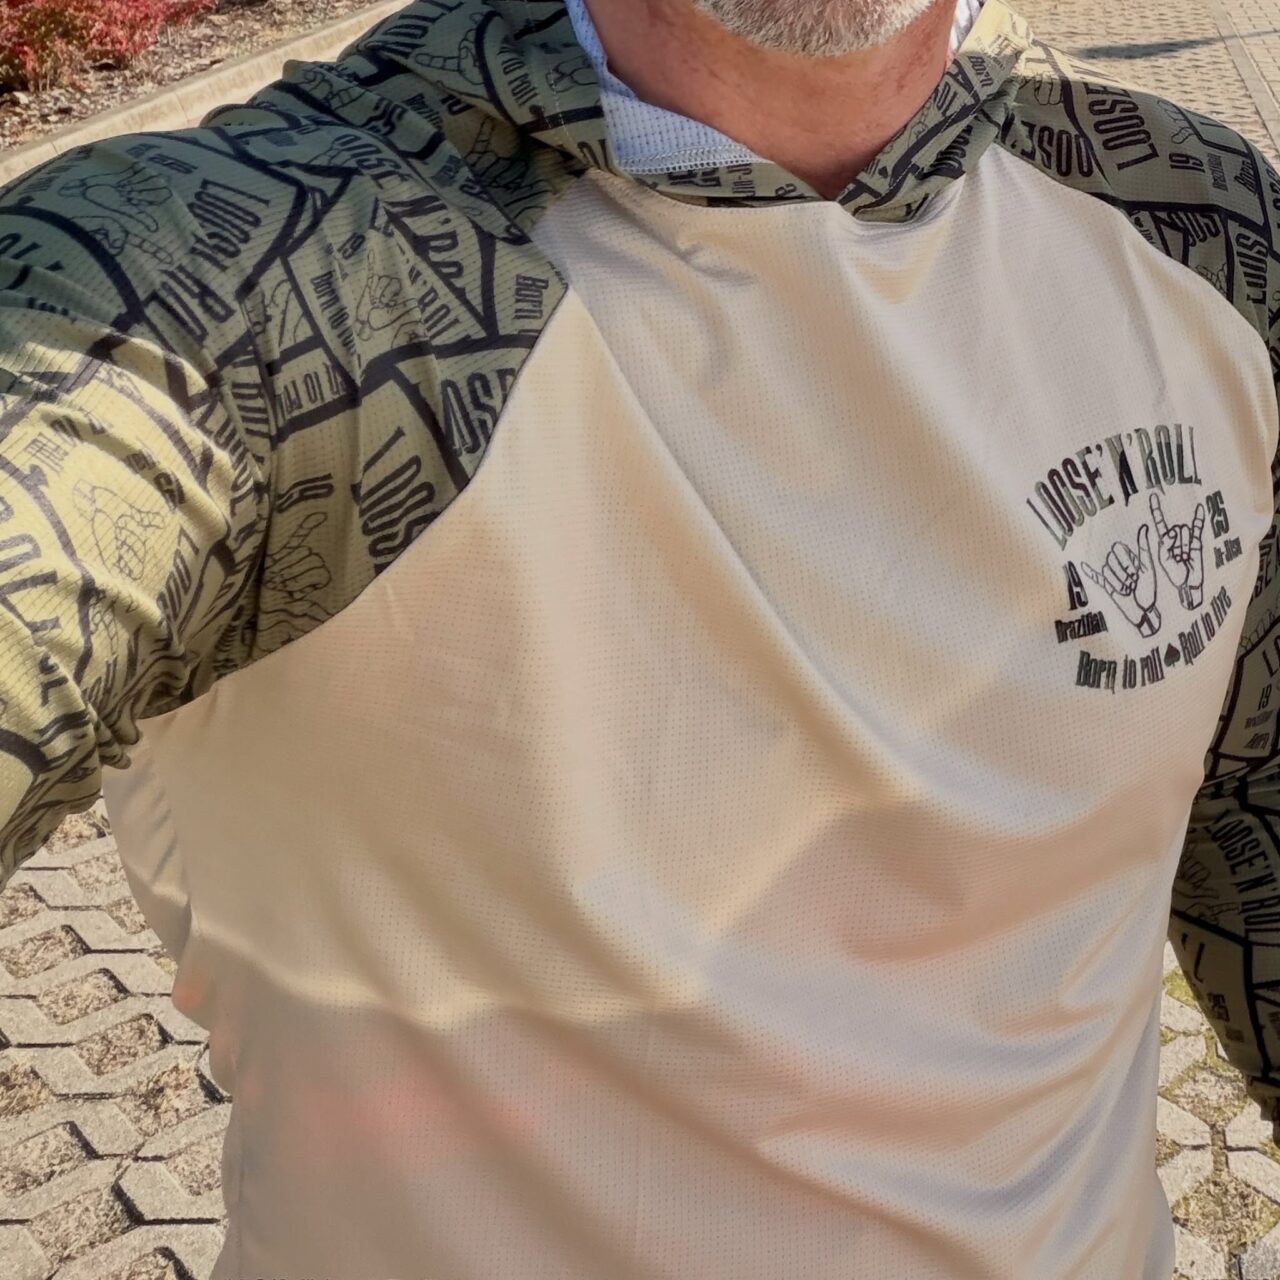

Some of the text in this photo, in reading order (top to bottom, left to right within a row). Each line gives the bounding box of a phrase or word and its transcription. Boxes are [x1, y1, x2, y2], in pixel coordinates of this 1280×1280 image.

[515, 274, 549, 320] Born
[1026, 423, 1202, 551] LOOSE'N'ROLL
[1062, 490, 1229, 610] 19 25
[1055, 611, 1108, 643] Brazilian
[1076, 586, 1232, 694] Born to roll Roll to live
